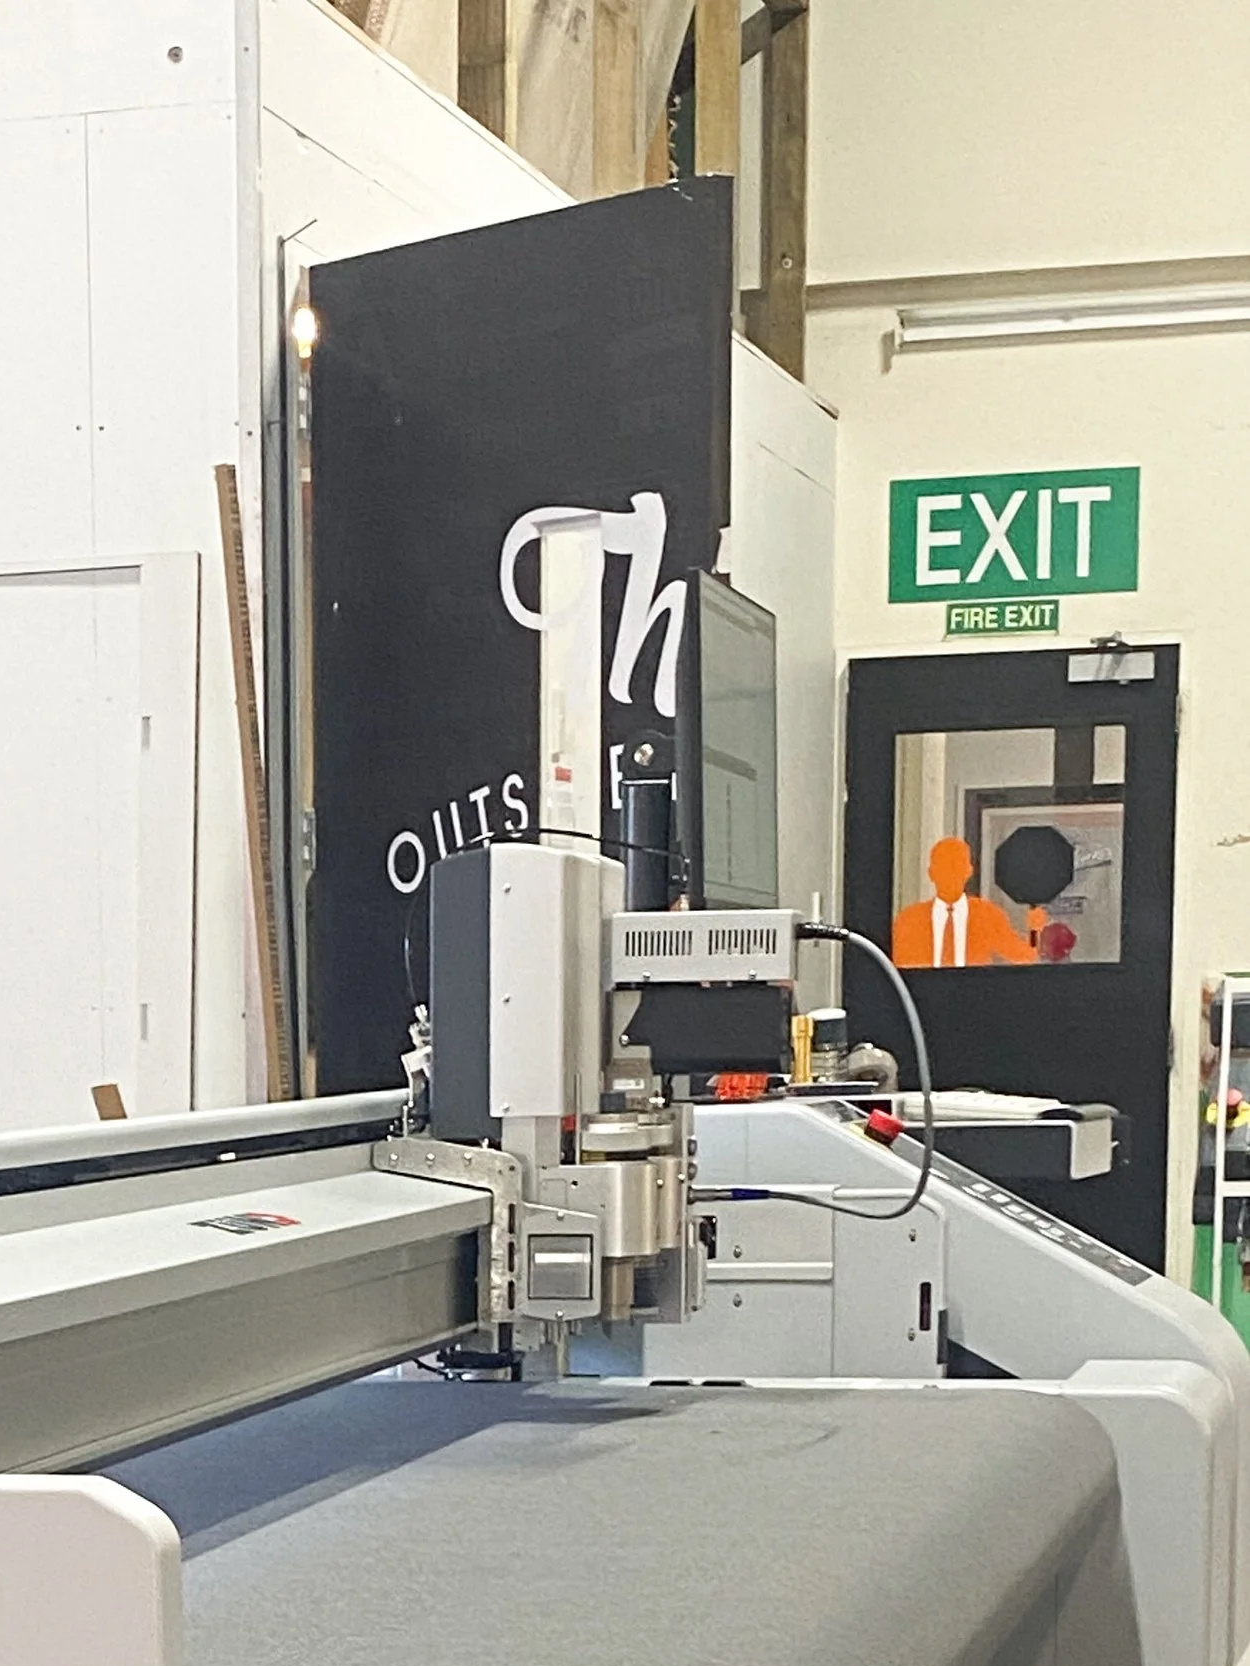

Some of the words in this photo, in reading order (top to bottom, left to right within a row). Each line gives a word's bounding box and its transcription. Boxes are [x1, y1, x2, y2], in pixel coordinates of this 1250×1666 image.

[915, 486, 1111, 586] EXIT
[950, 608, 998, 629] FIRE
[1004, 604, 1055, 627] EXIT
